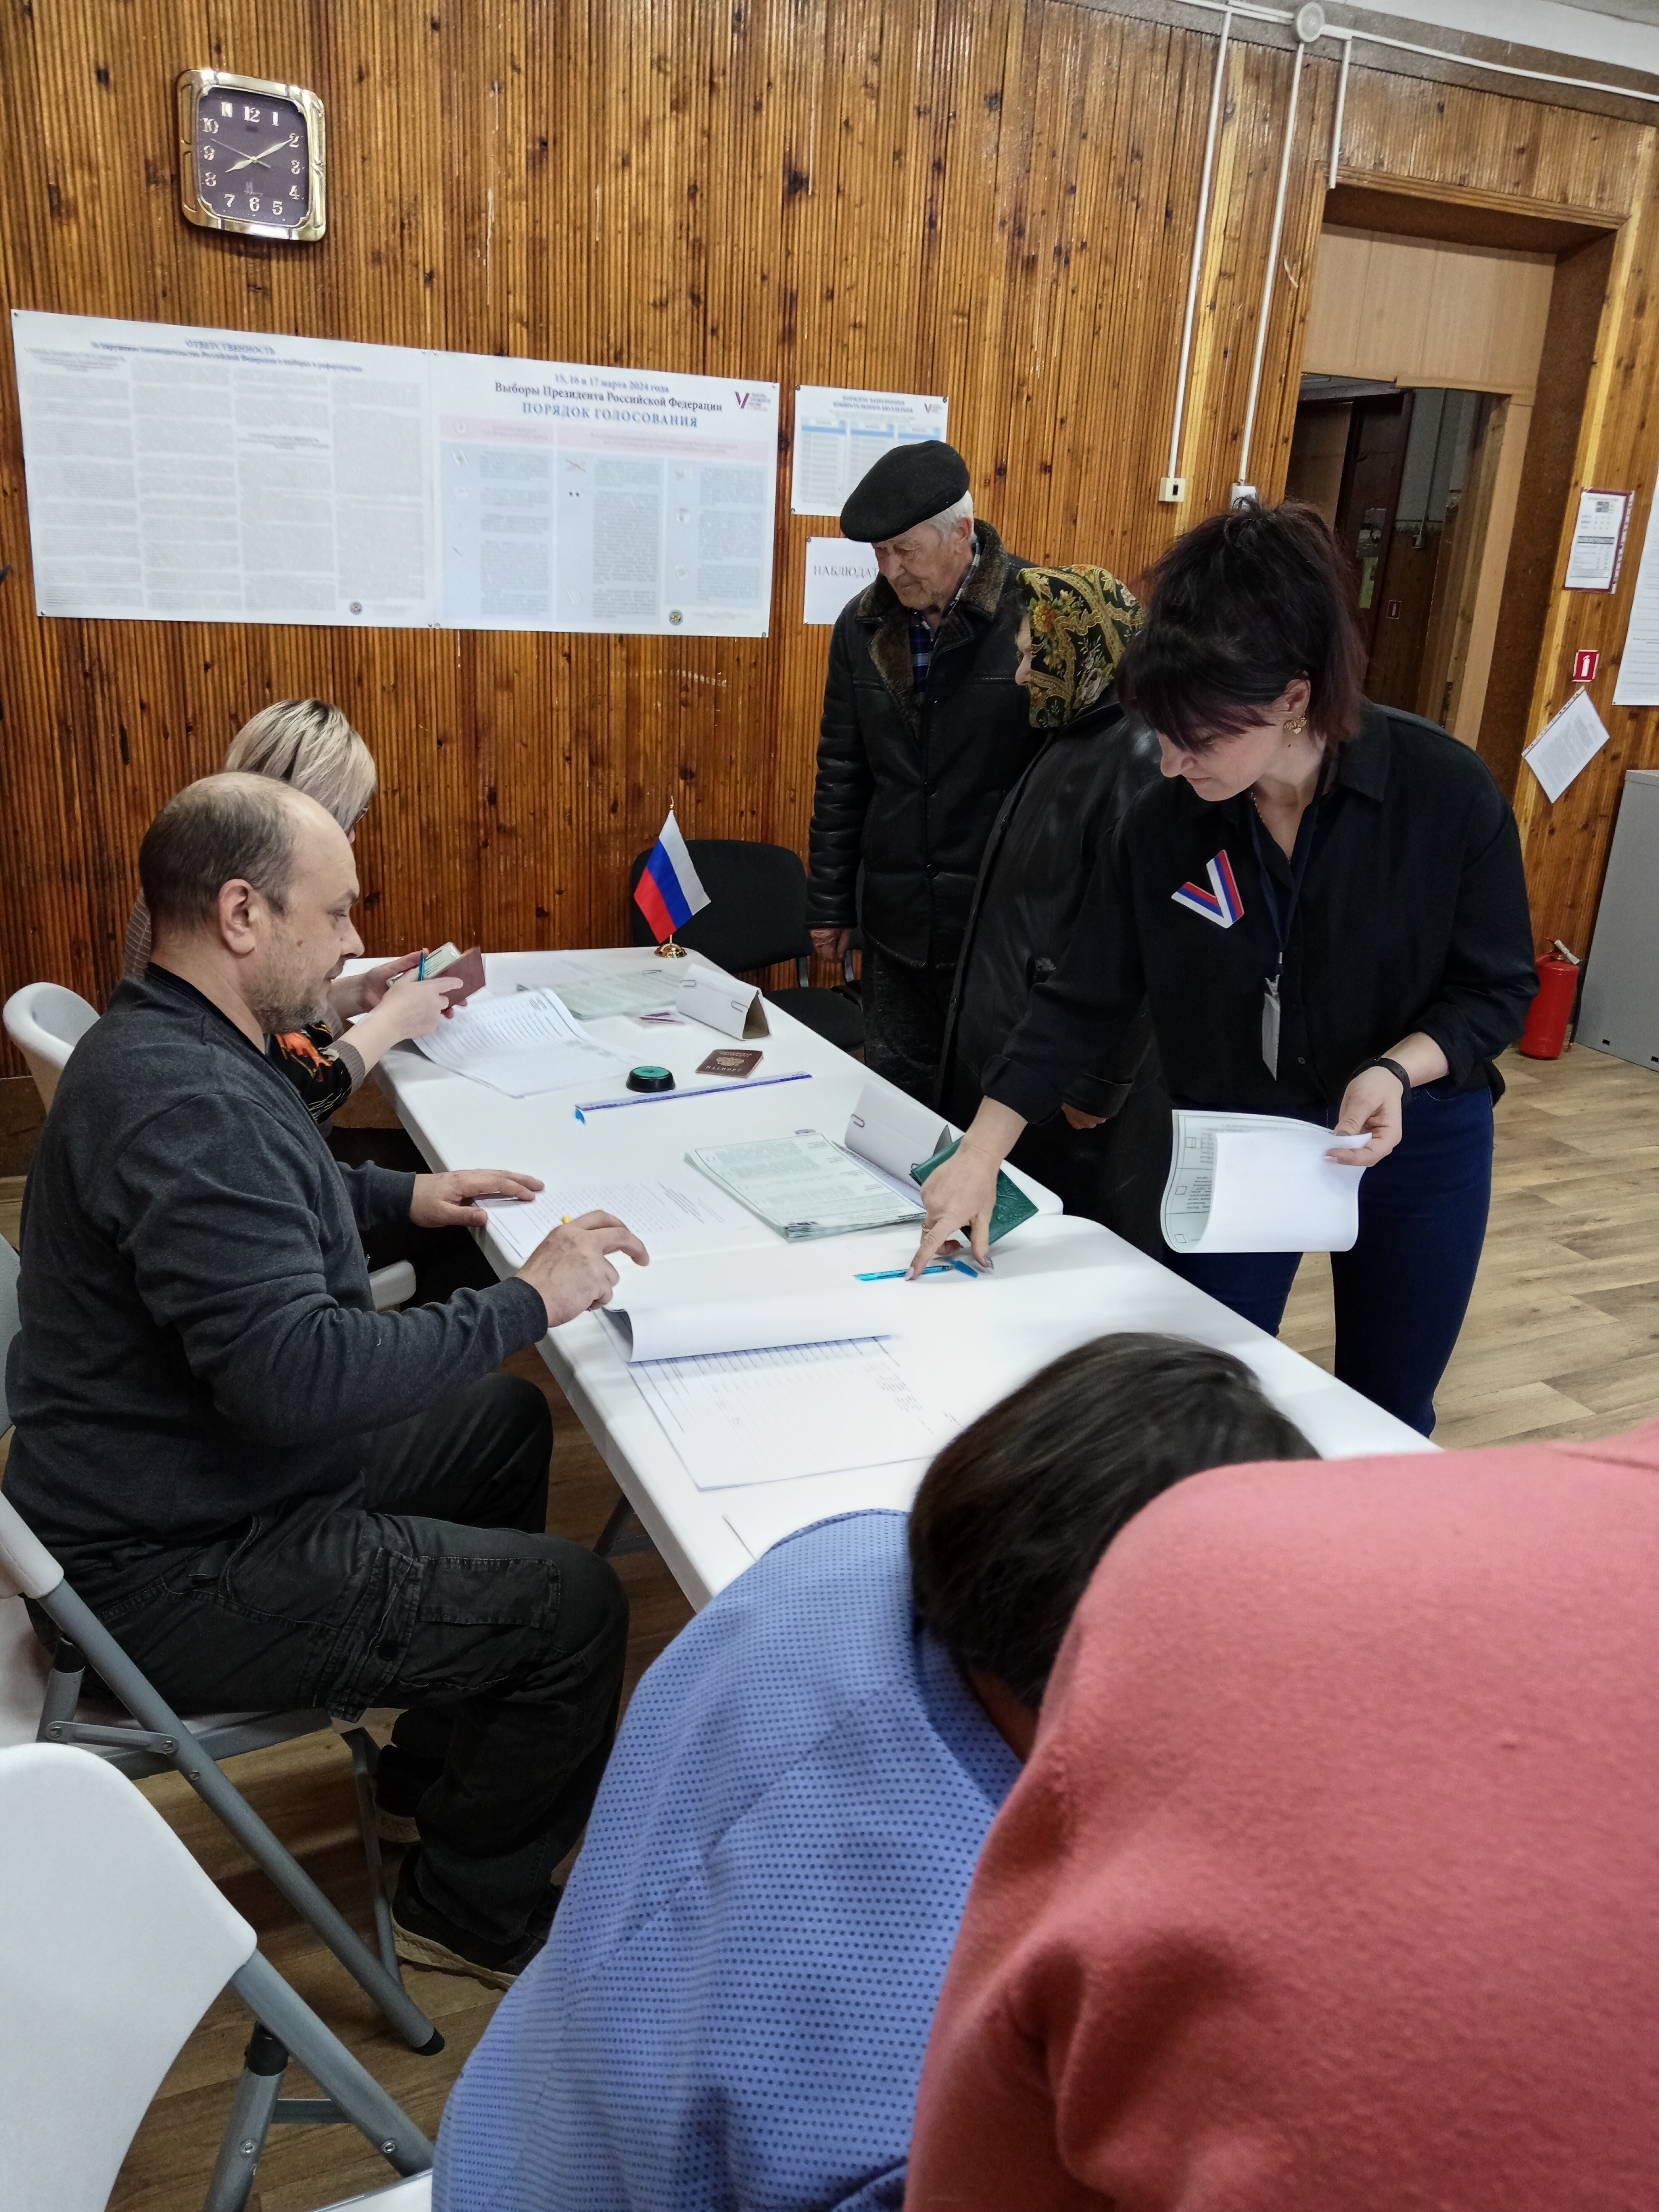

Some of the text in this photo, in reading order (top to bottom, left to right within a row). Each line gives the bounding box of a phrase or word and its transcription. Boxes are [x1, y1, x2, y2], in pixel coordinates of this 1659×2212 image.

[244, 106, 260, 123] 12
[272, 112, 279, 126] 1
[202, 118, 219, 134] 10
[289, 133, 301, 148] 2
[204, 145, 215, 160] 9
[291, 160, 301, 175] 3
[205, 172, 217, 186] 8
[289, 185, 301, 200] 4
[224, 194, 235, 207] 7
[249, 197, 260, 211] 6
[272, 201, 283, 215] 5
[601, 380, 627, 390] марта
[495, 381, 723, 412] Выборы Президента Российской Федерации
[522, 402, 698, 428] ПОРЯДОК ГОЛОСОВАНИЯ
